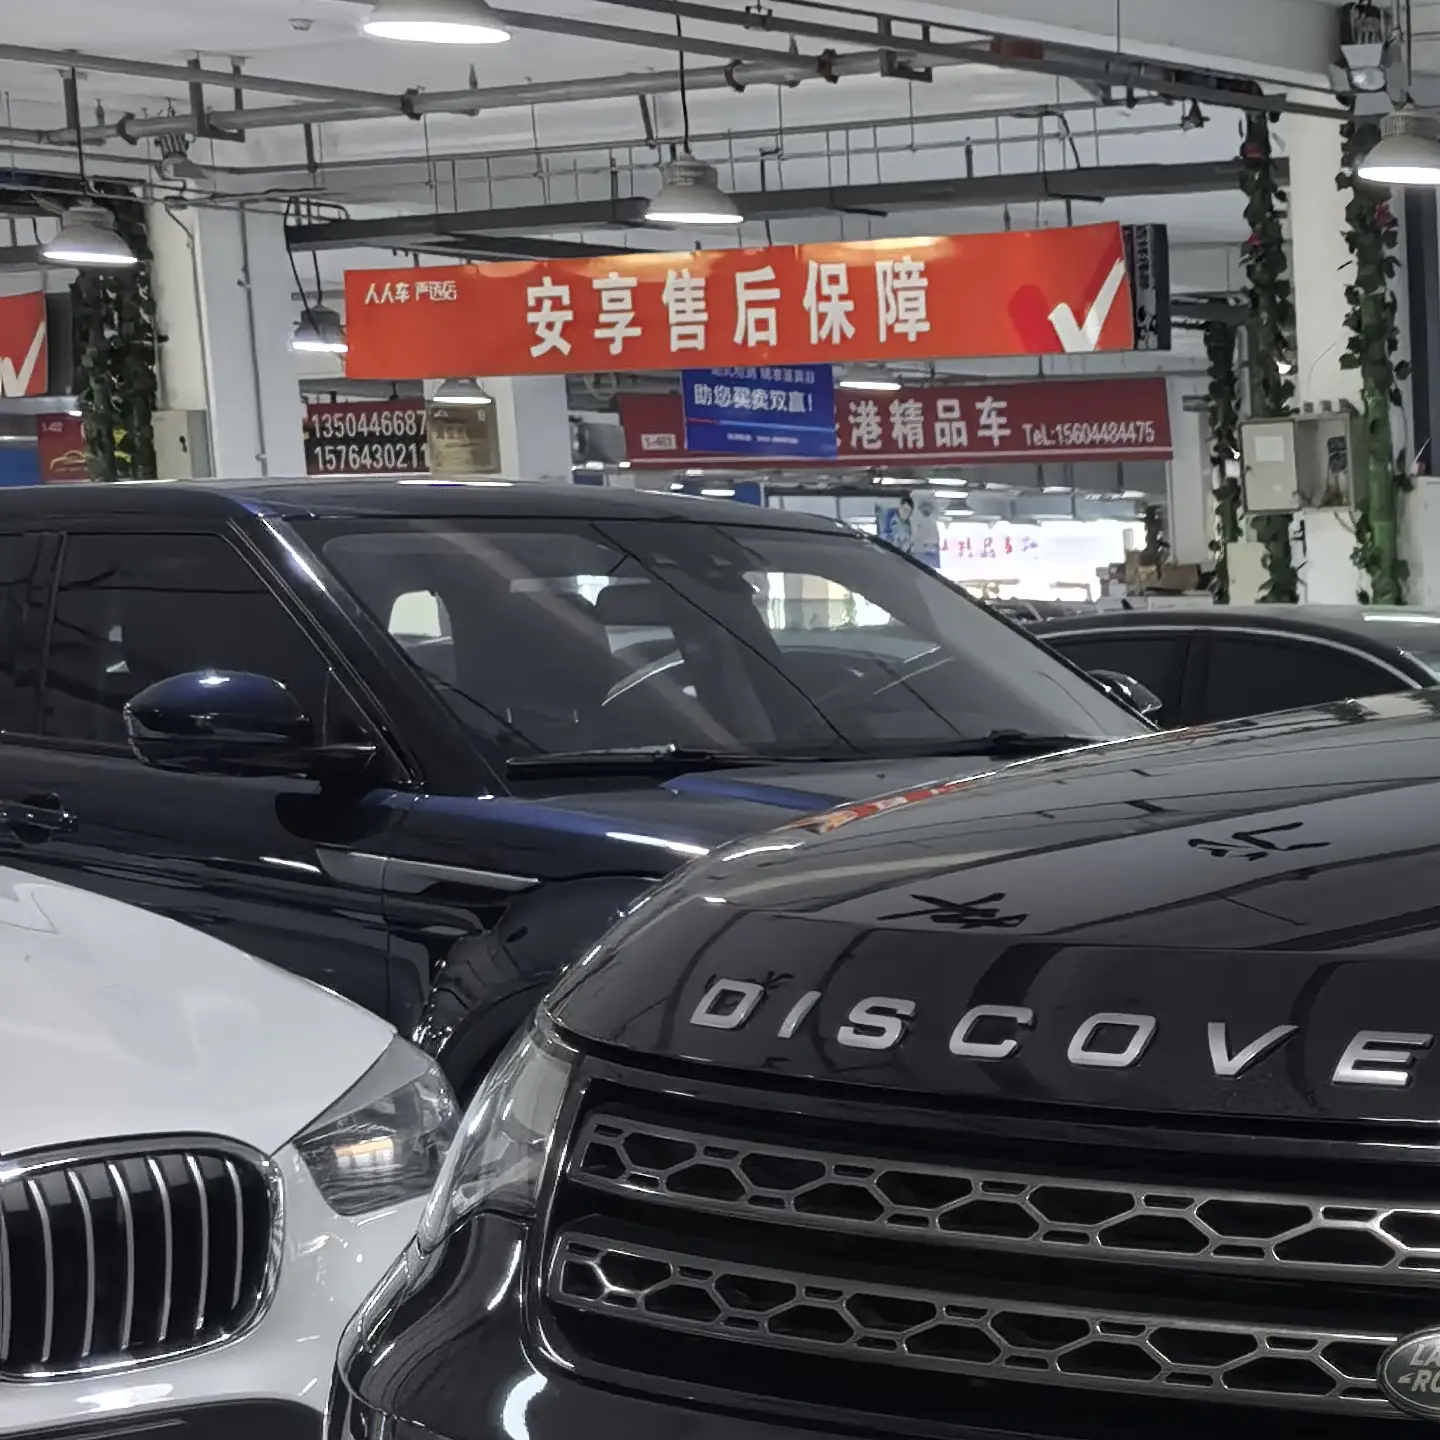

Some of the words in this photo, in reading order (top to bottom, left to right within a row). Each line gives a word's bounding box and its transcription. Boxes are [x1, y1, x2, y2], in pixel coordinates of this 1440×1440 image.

[364, 281, 410, 305] 人人车
[526, 255, 931, 358] 安享售后保障
[834, 396, 1011, 449] 港精品车
